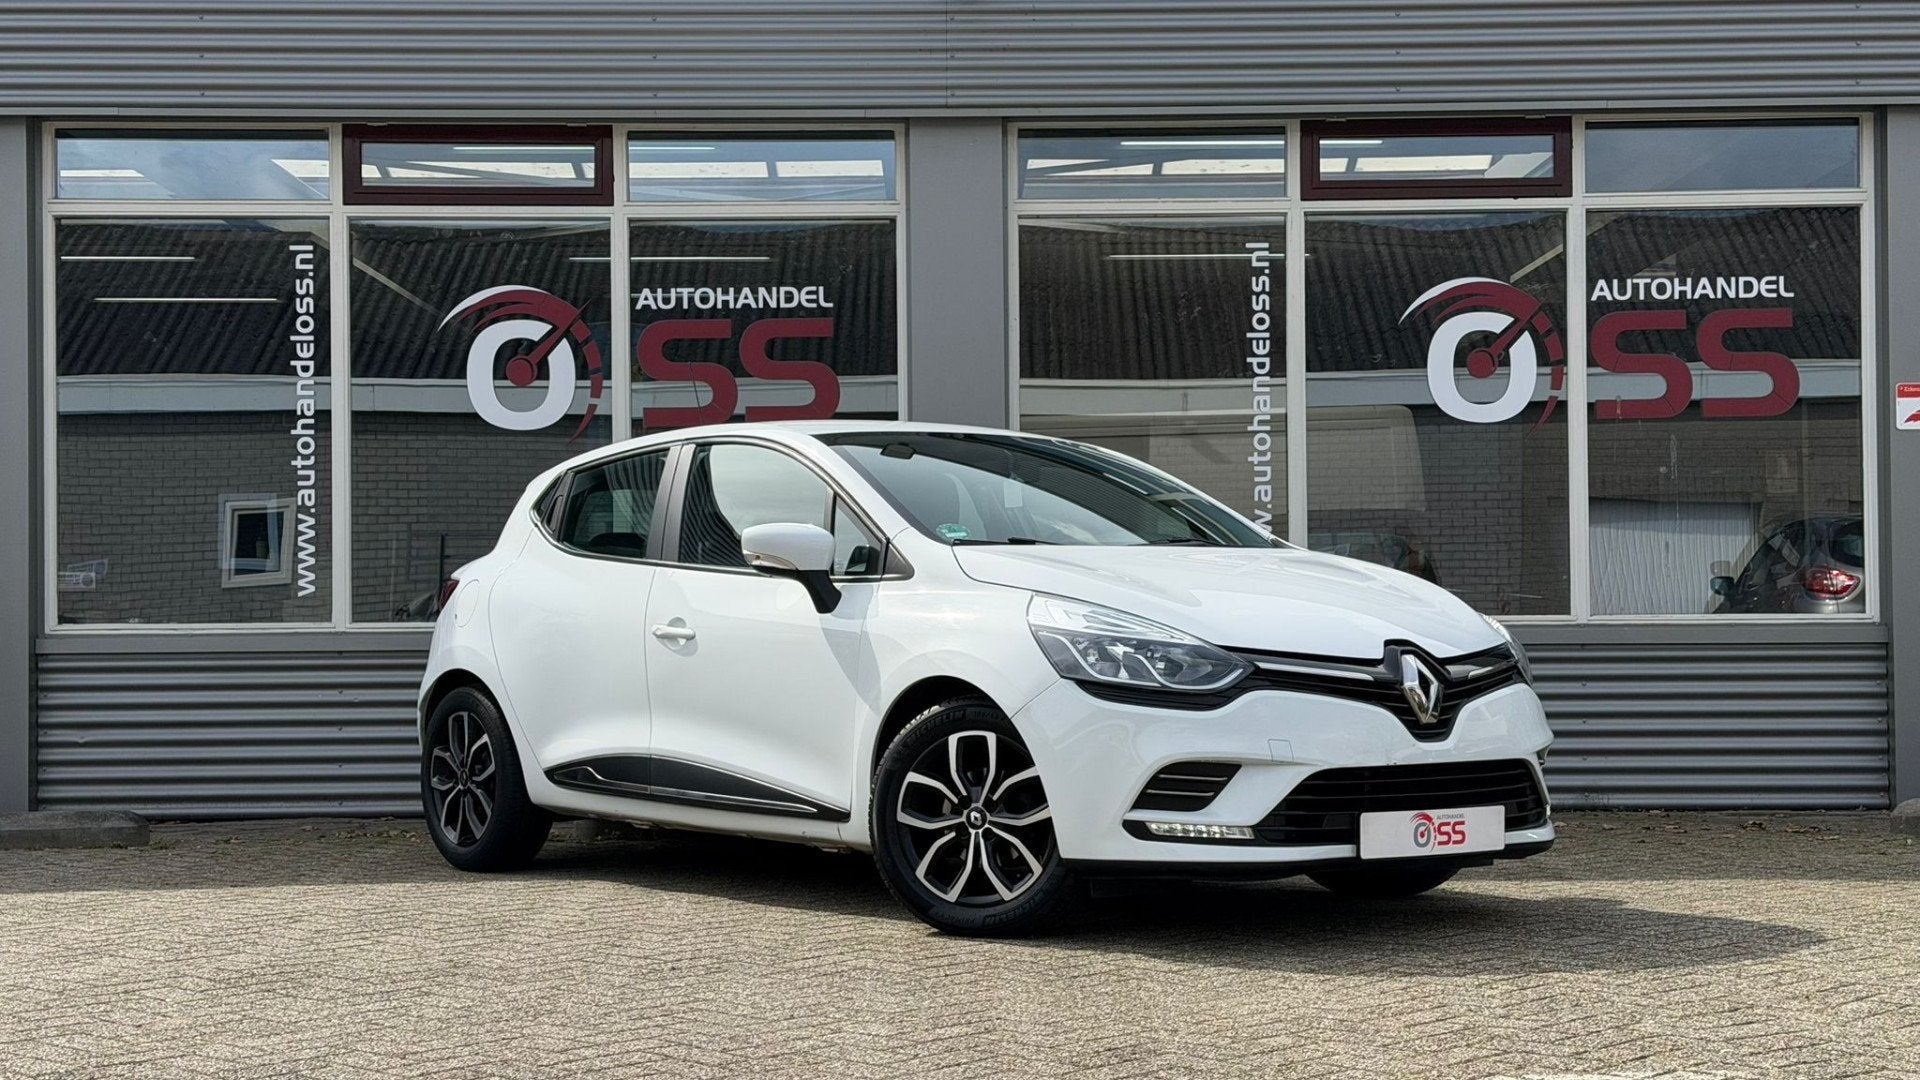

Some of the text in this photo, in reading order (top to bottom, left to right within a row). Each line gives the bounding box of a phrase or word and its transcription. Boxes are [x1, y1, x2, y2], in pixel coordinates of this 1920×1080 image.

[635, 286, 834, 310] AUTOHANDEL
[1591, 275, 1795, 301] AUTOHANDEL
[289, 245, 315, 597] www.autohandeloss.nl
[1413, 820, 1467, 848] OSS
